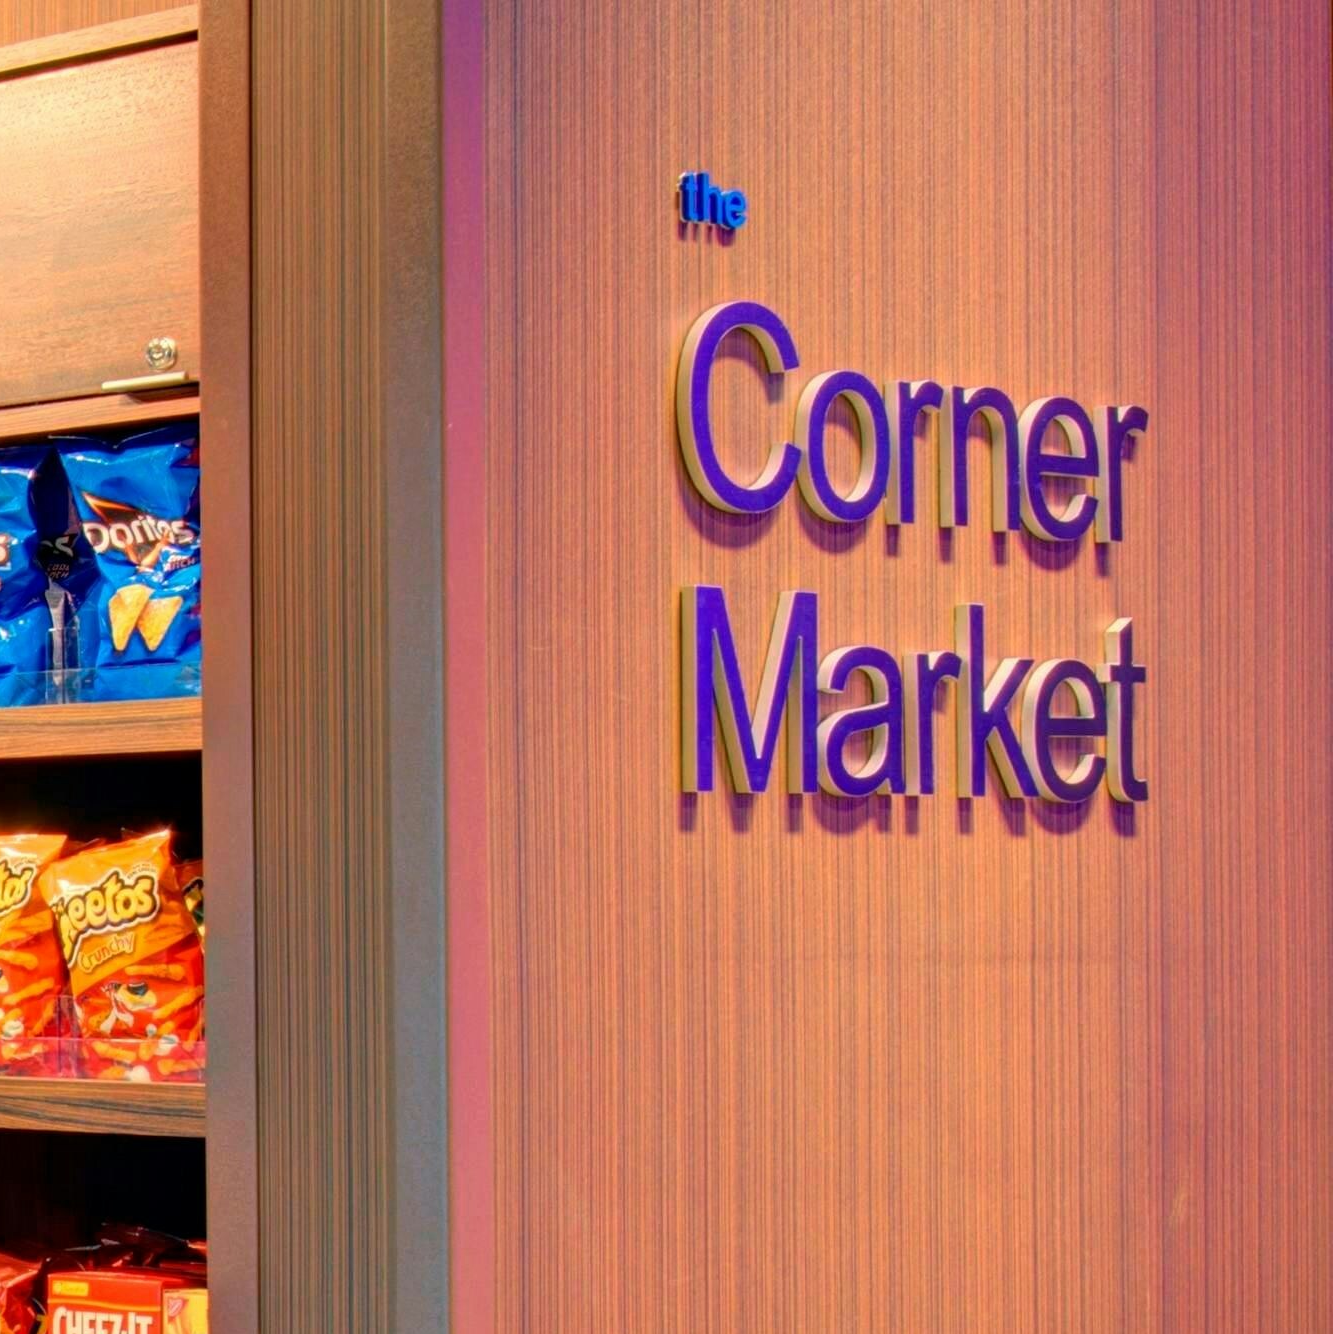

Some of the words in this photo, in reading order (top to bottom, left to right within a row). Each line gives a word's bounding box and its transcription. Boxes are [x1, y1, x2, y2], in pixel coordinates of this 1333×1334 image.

[679, 172, 748, 230] the
[676, 301, 1149, 542] Corner
[83, 514, 195, 552] Doritos
[680, 584, 1149, 802] Market
